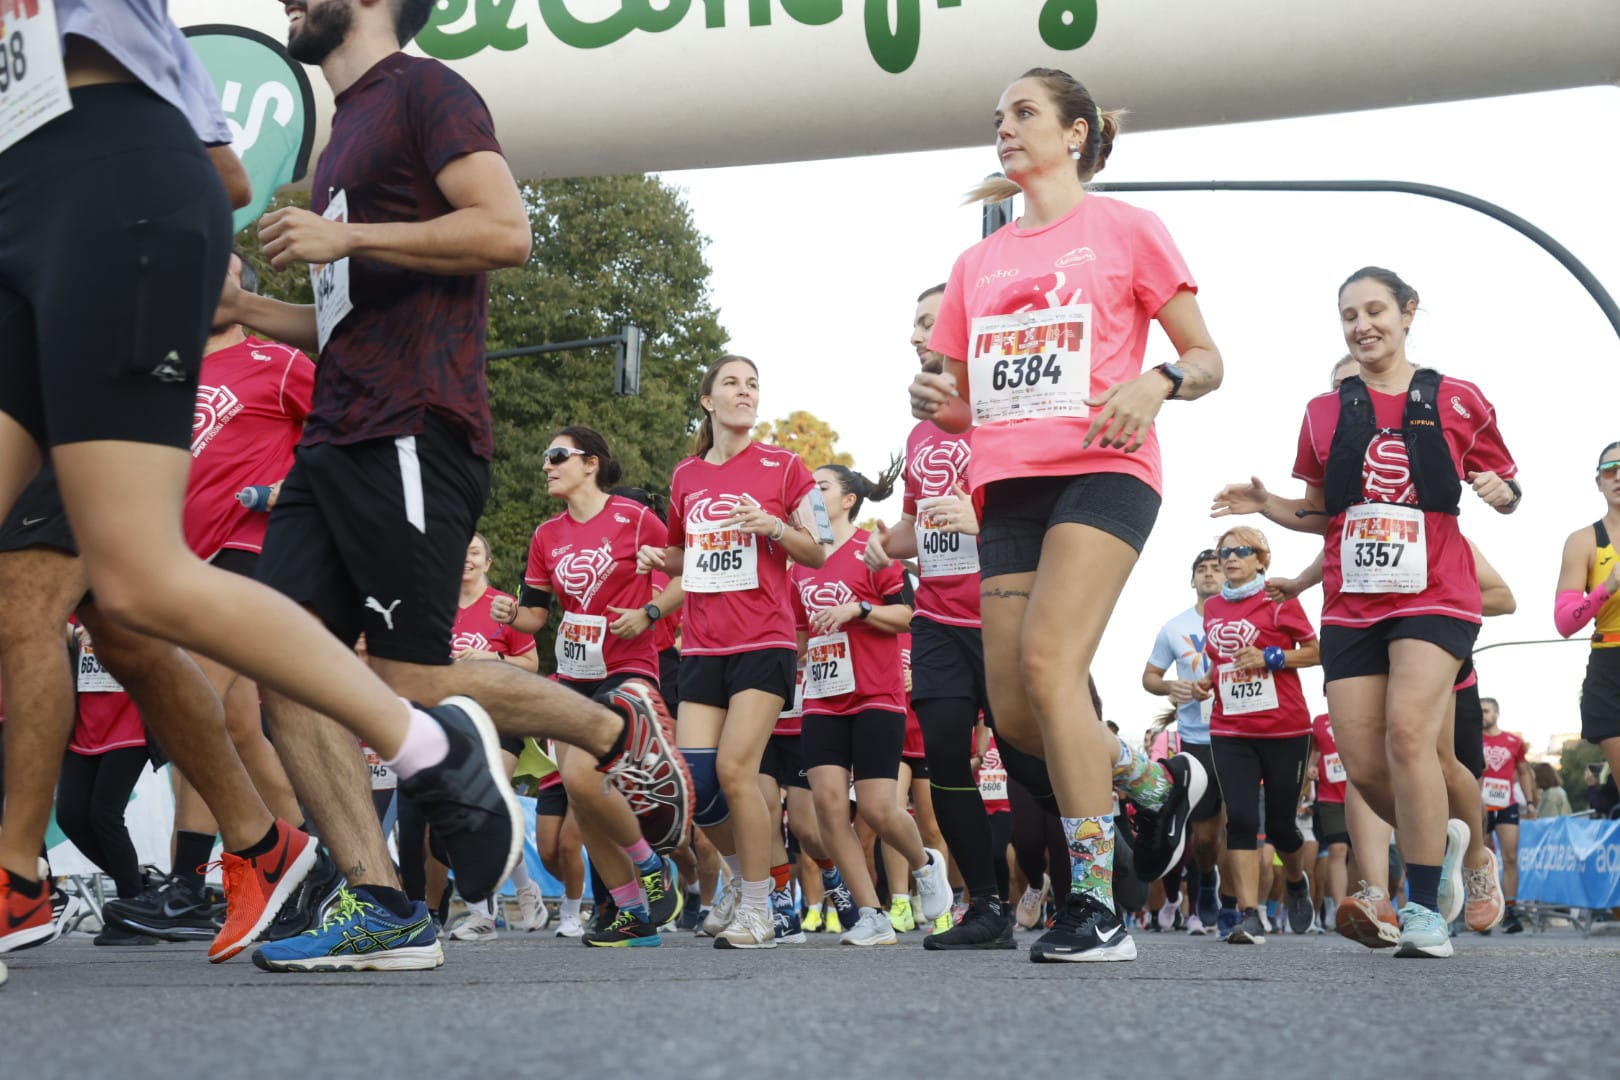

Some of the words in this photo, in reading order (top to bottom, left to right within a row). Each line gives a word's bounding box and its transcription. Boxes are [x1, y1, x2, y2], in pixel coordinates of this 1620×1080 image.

[992, 353, 1062, 391] 6384
[1409, 419, 1436, 428] KIPRUN
[923, 531, 960, 555] 4060
[695, 548, 743, 573] 4065
[1354, 542, 1405, 568] 3357
[563, 640, 587, 662] 5071
[811, 660, 838, 682] 5072
[1231, 681, 1263, 699] 4732
